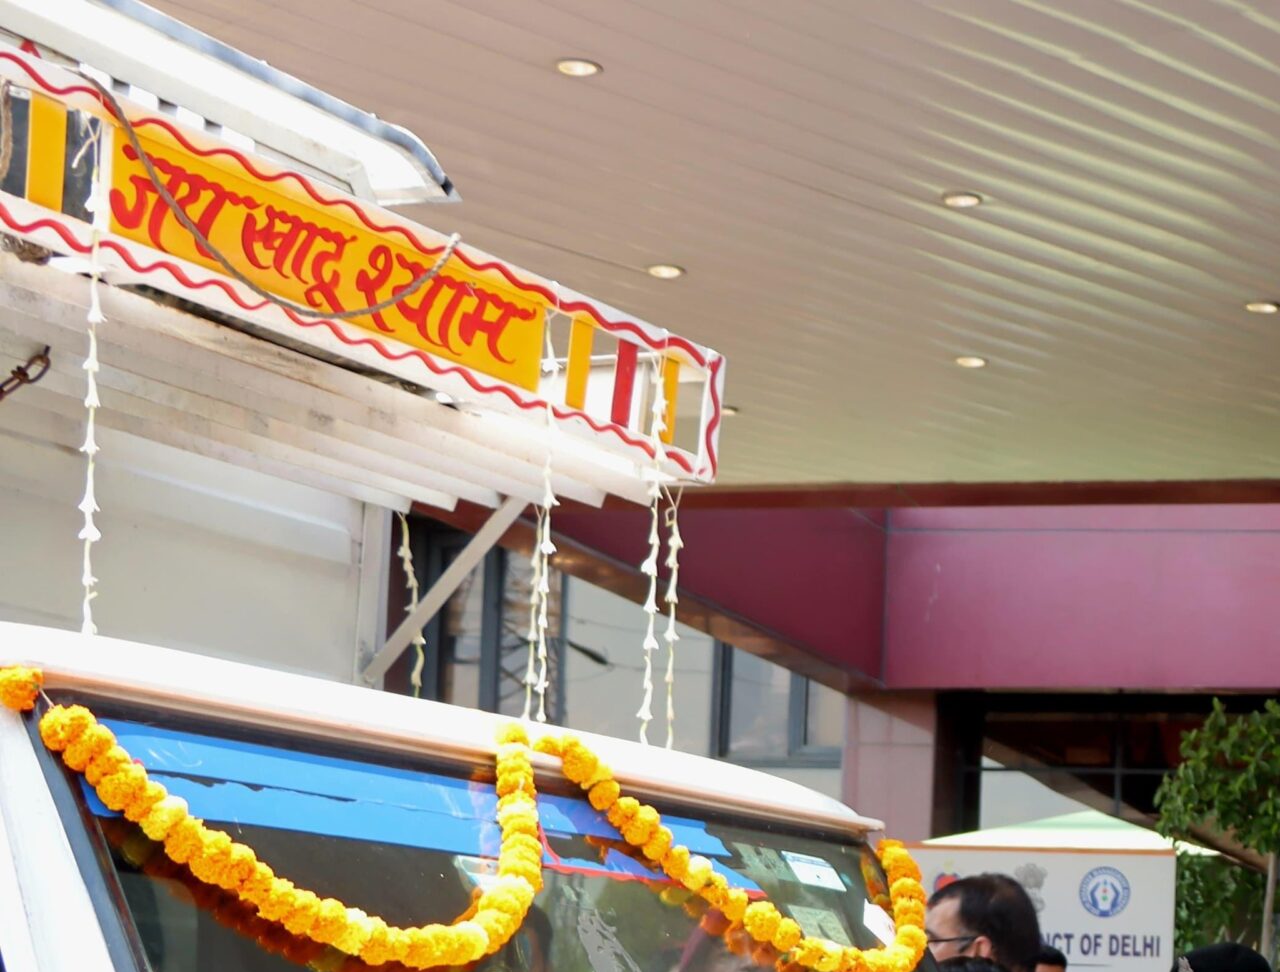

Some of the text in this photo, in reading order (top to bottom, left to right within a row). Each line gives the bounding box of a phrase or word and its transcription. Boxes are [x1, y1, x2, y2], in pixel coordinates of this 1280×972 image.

[109, 144, 264, 263] जय
[356, 244, 537, 364] श्याम
[1080, 933, 1103, 956] OF
[1109, 934, 1160, 957] DELHI
